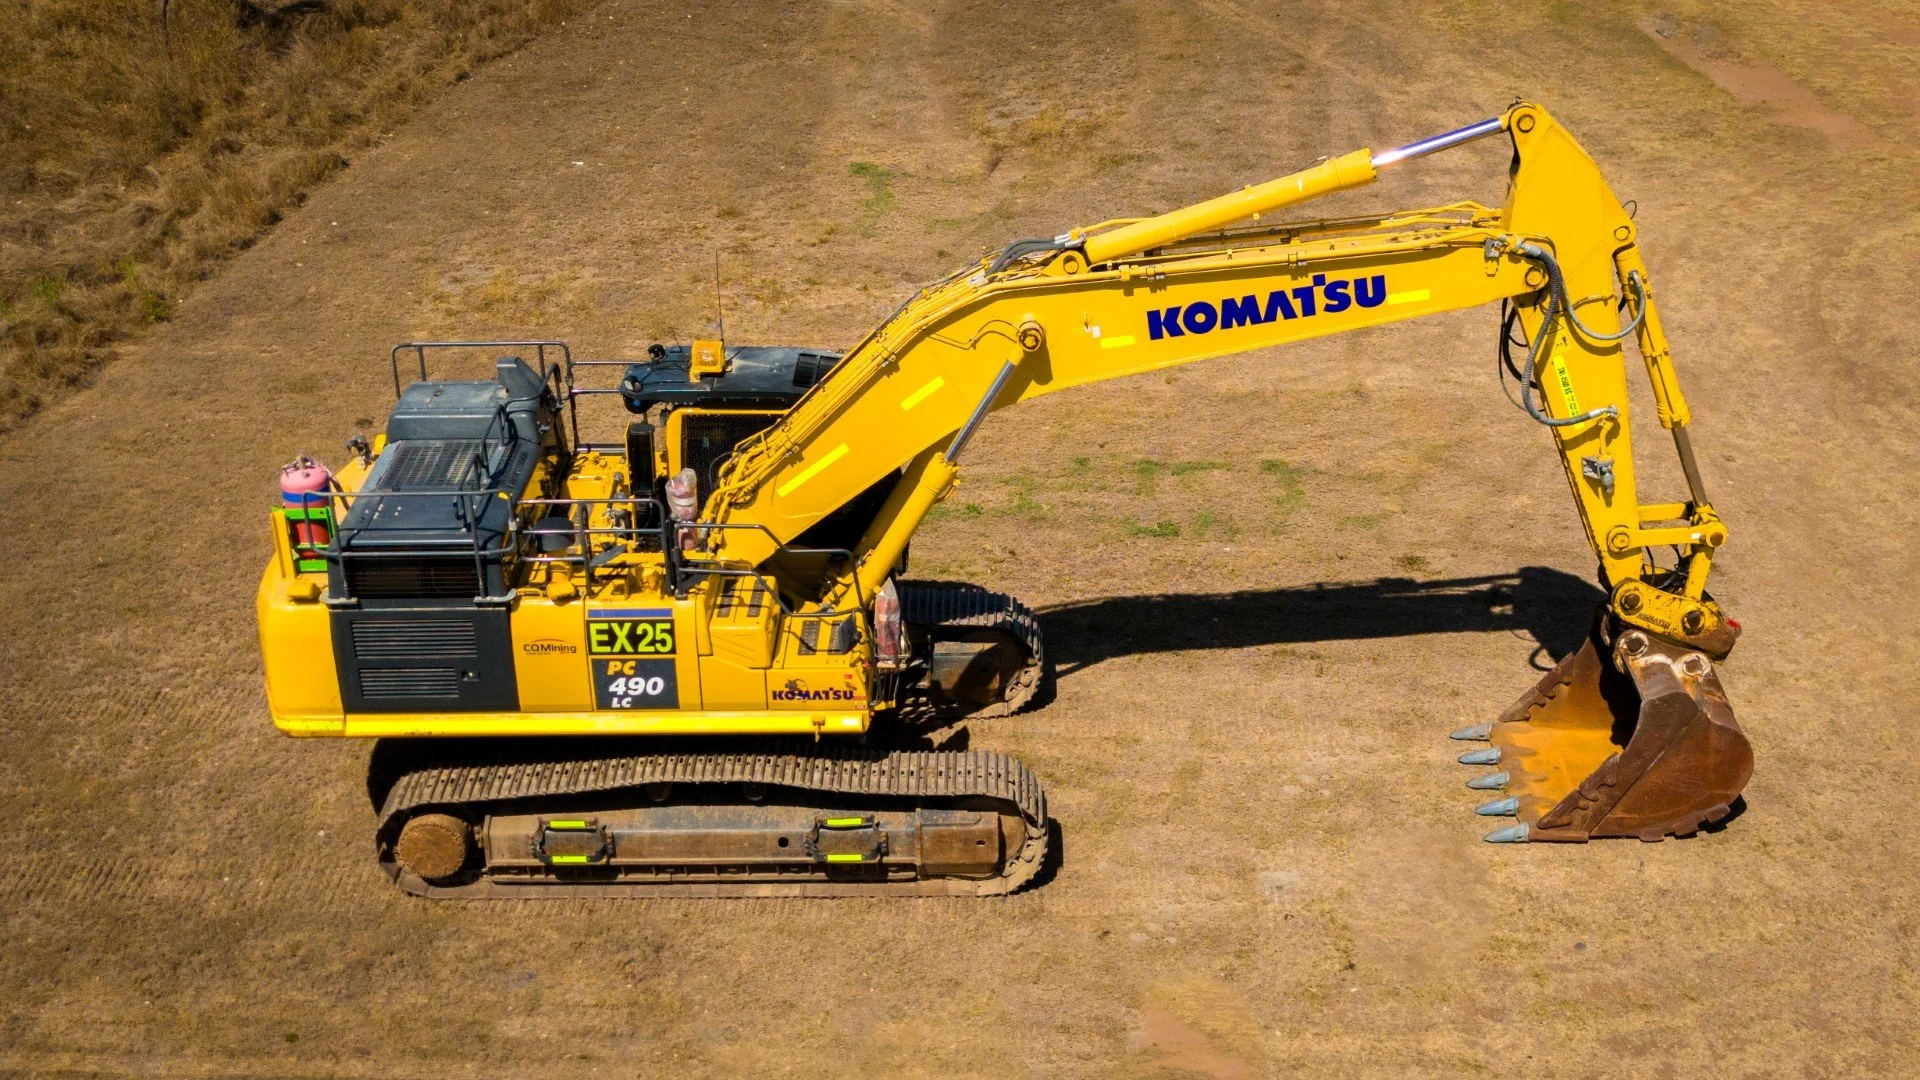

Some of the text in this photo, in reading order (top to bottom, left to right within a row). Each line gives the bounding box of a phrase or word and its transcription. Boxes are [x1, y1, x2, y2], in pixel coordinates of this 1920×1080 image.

[1146, 274, 1387, 340] KOMATSU
[607, 660, 636, 676] PC
[608, 676, 665, 696] 490
[611, 697, 632, 709] LC
